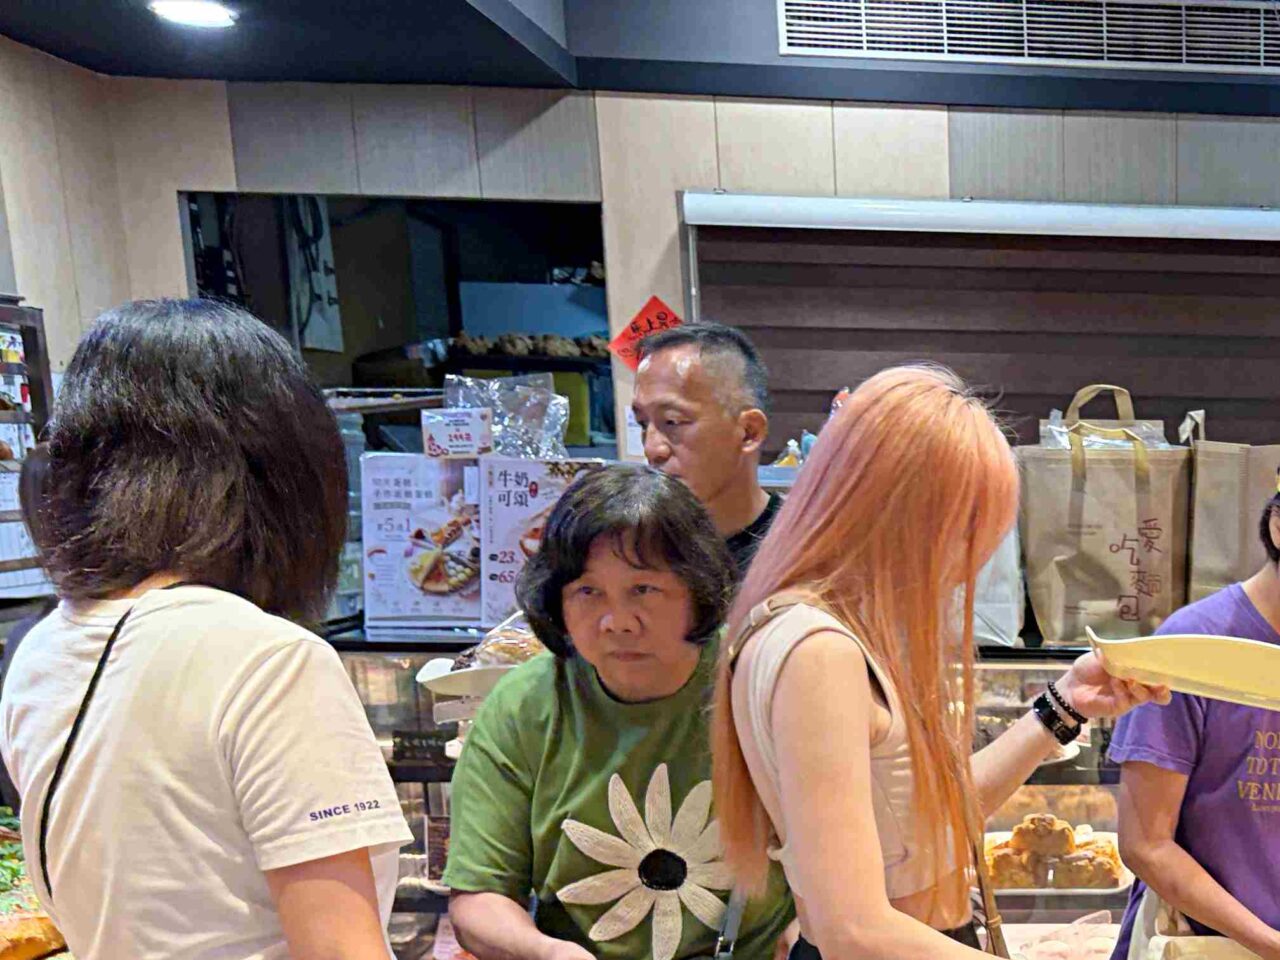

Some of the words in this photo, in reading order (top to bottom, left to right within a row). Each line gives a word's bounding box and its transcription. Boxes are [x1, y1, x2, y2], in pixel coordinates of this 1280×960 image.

[499, 470, 529, 488] 牛奶
[498, 490, 529, 507] 可頌
[309, 804, 351, 821] SINCE
[354, 800, 381, 812] 1922
